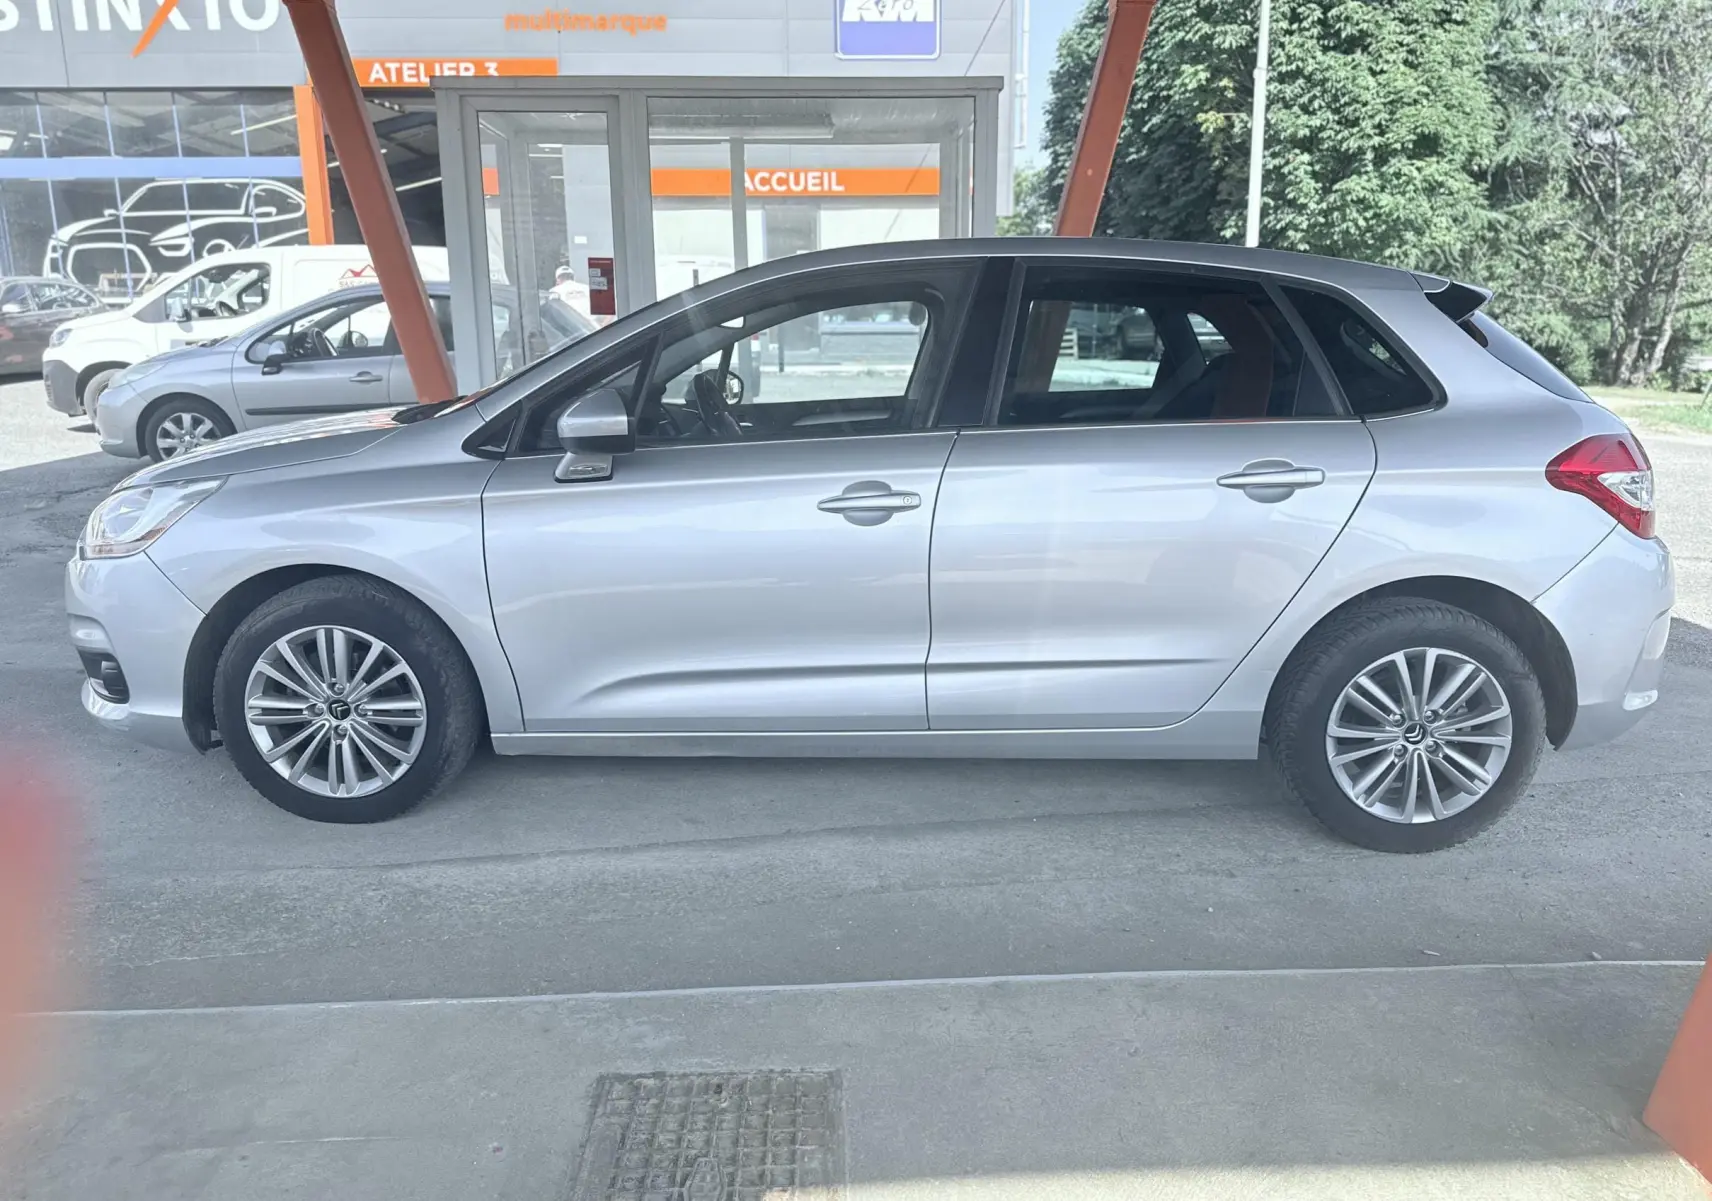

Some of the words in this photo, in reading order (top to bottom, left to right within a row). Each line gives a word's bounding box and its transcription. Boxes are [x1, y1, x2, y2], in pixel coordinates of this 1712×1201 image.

[503, 9, 667, 36] multimarque
[368, 62, 475, 83] ATELIER
[744, 172, 845, 192] ACCUEIL
